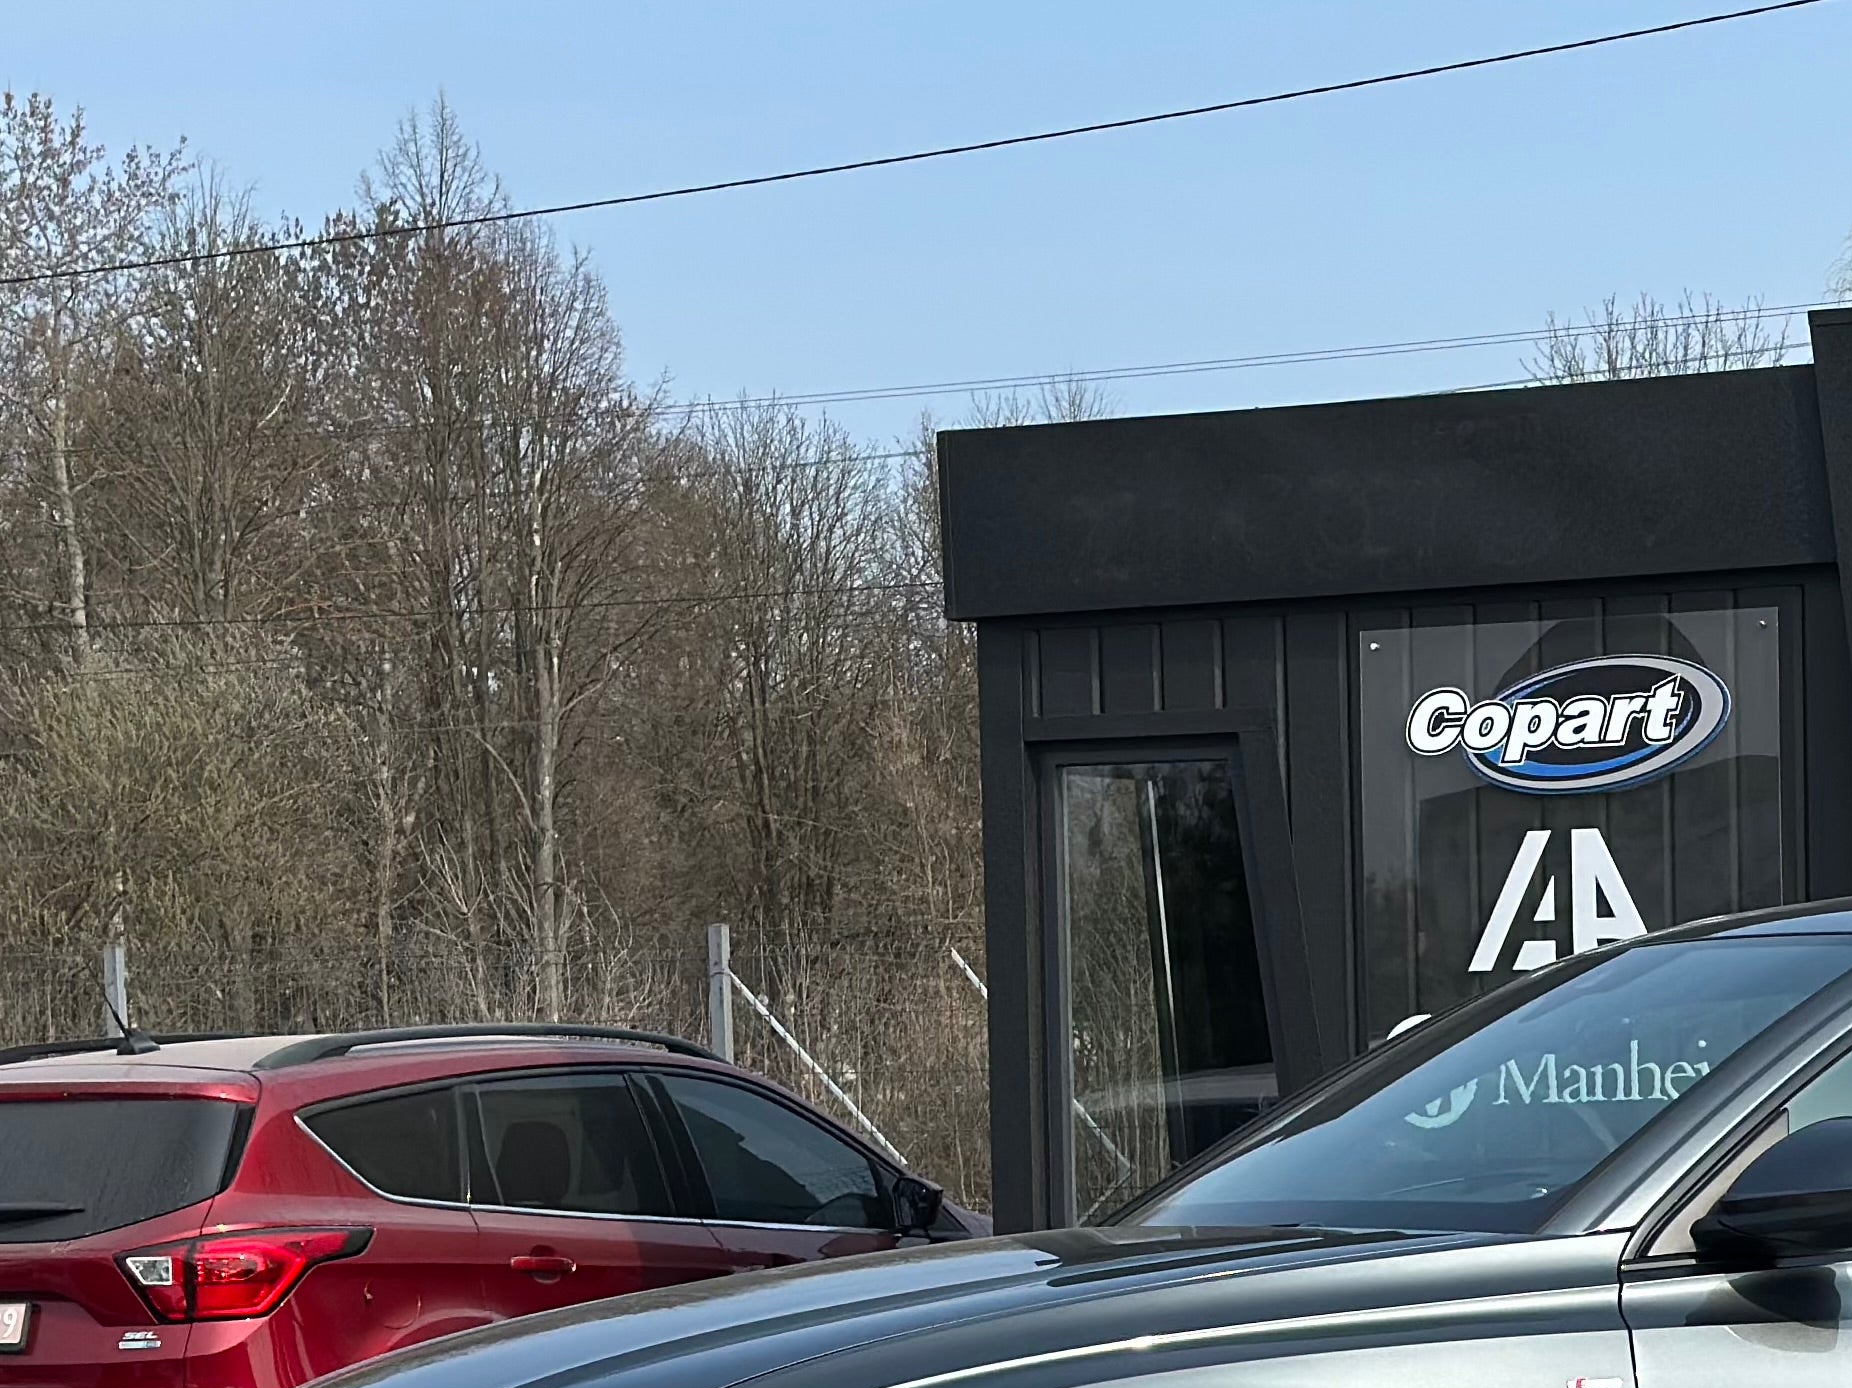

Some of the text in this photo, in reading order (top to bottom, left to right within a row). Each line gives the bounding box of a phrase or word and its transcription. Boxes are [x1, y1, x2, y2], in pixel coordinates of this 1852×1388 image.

[1406, 673, 1685, 766] Copart
[1492, 1038, 1711, 1104] Manhei
[0, 1308, 18, 1339] 9
[122, 1331, 158, 1340] SEL
